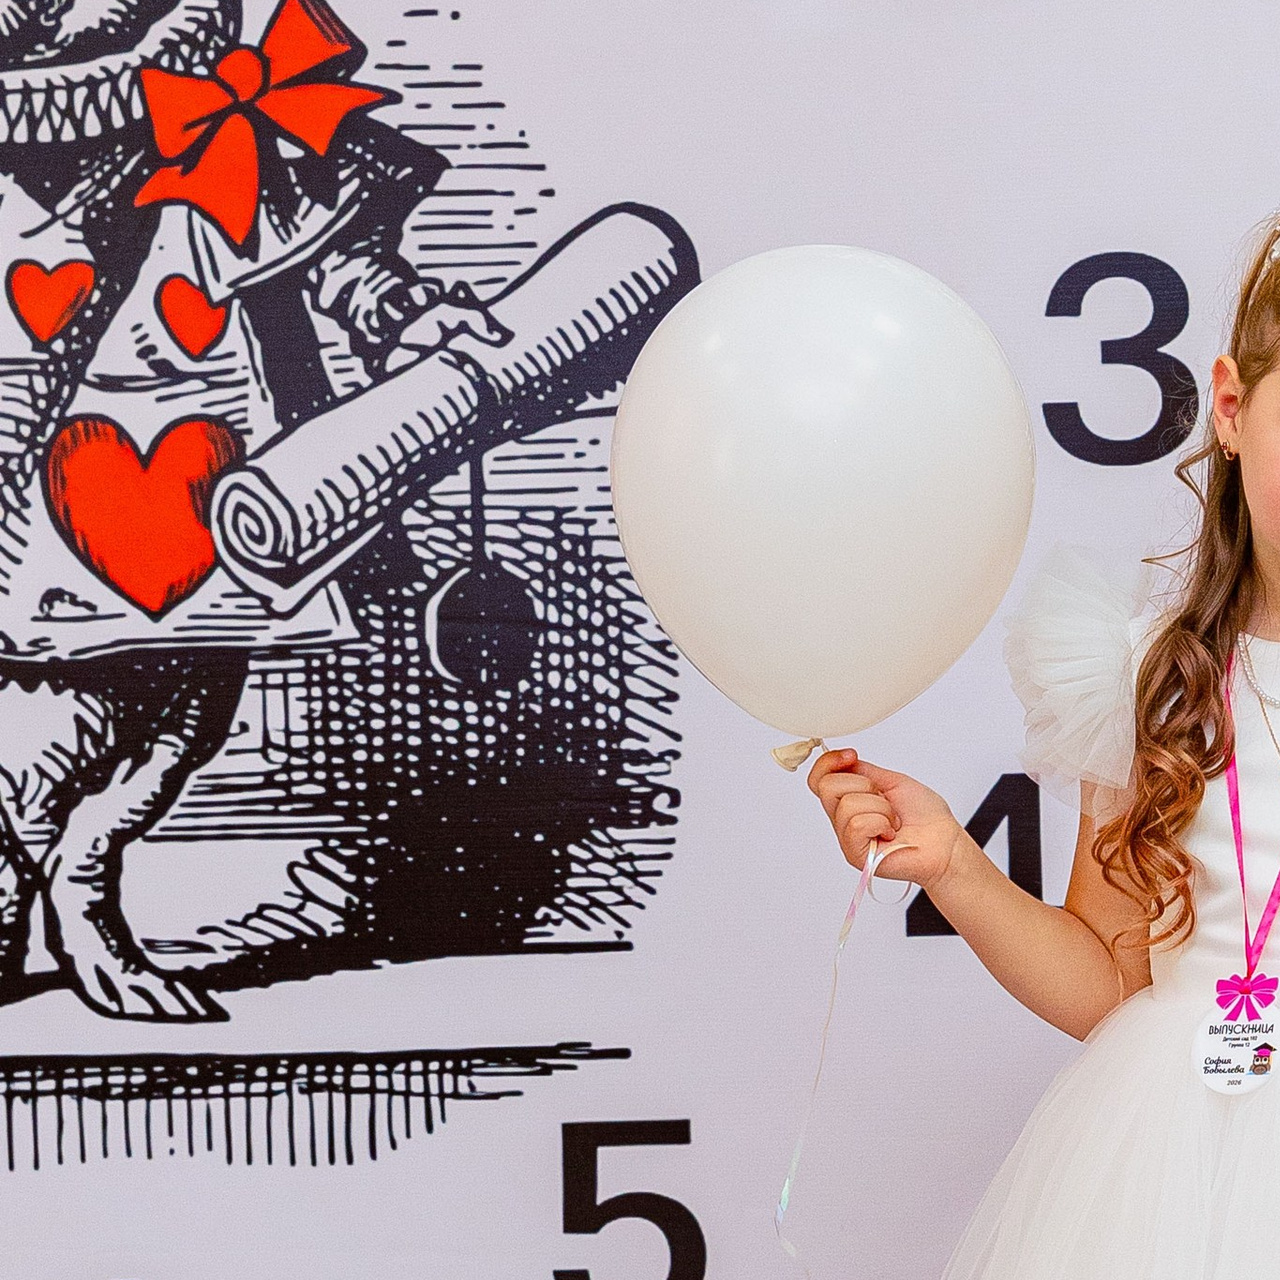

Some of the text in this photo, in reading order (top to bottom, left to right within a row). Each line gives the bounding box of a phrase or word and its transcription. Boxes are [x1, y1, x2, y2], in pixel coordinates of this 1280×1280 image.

[1042, 251, 1200, 467] 3
[1208, 1024, 1274, 1035] ВЫПУСКНИЦА
[1204, 1056, 1232, 1067] София
